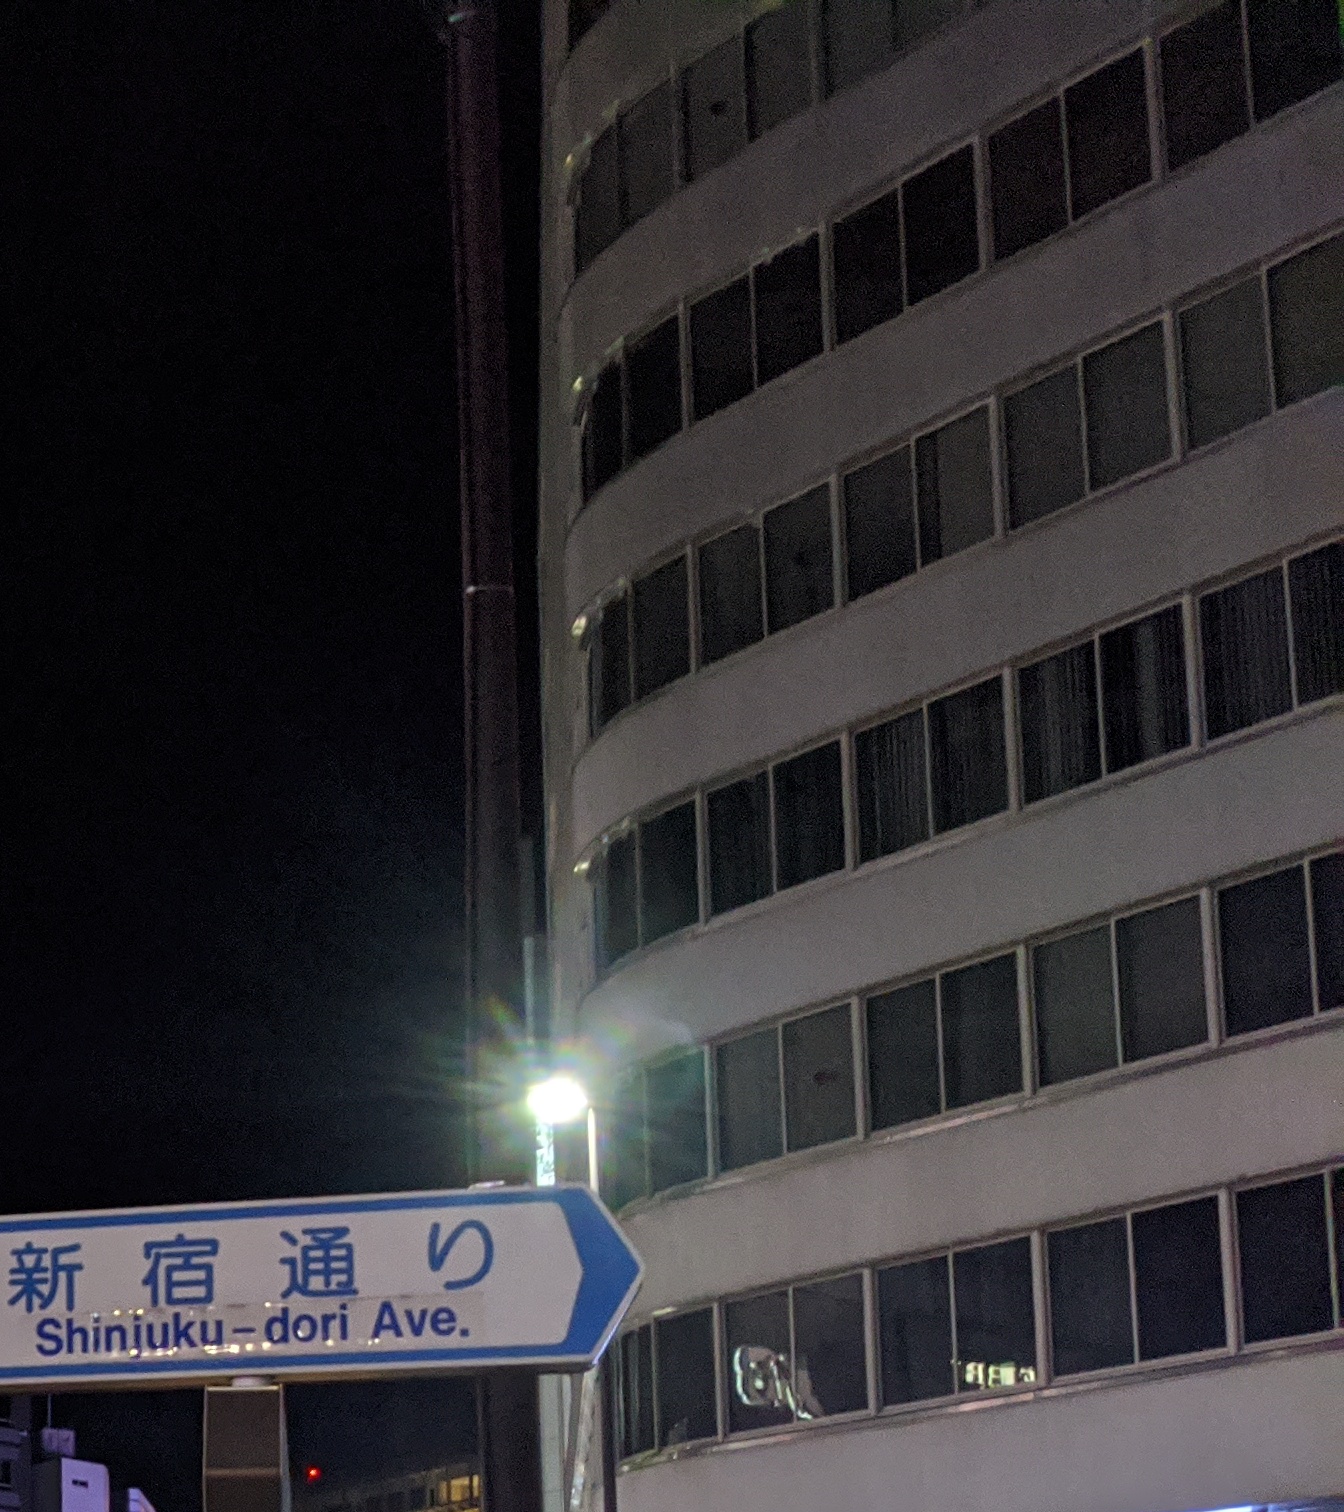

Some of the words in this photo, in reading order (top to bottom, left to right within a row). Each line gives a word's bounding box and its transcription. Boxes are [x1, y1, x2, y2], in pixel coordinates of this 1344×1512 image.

[8, 1217, 495, 1314] 新宿通り
[35, 1302, 350, 1359] Shinjuku-dori
[371, 1300, 471, 1341] Ave.
